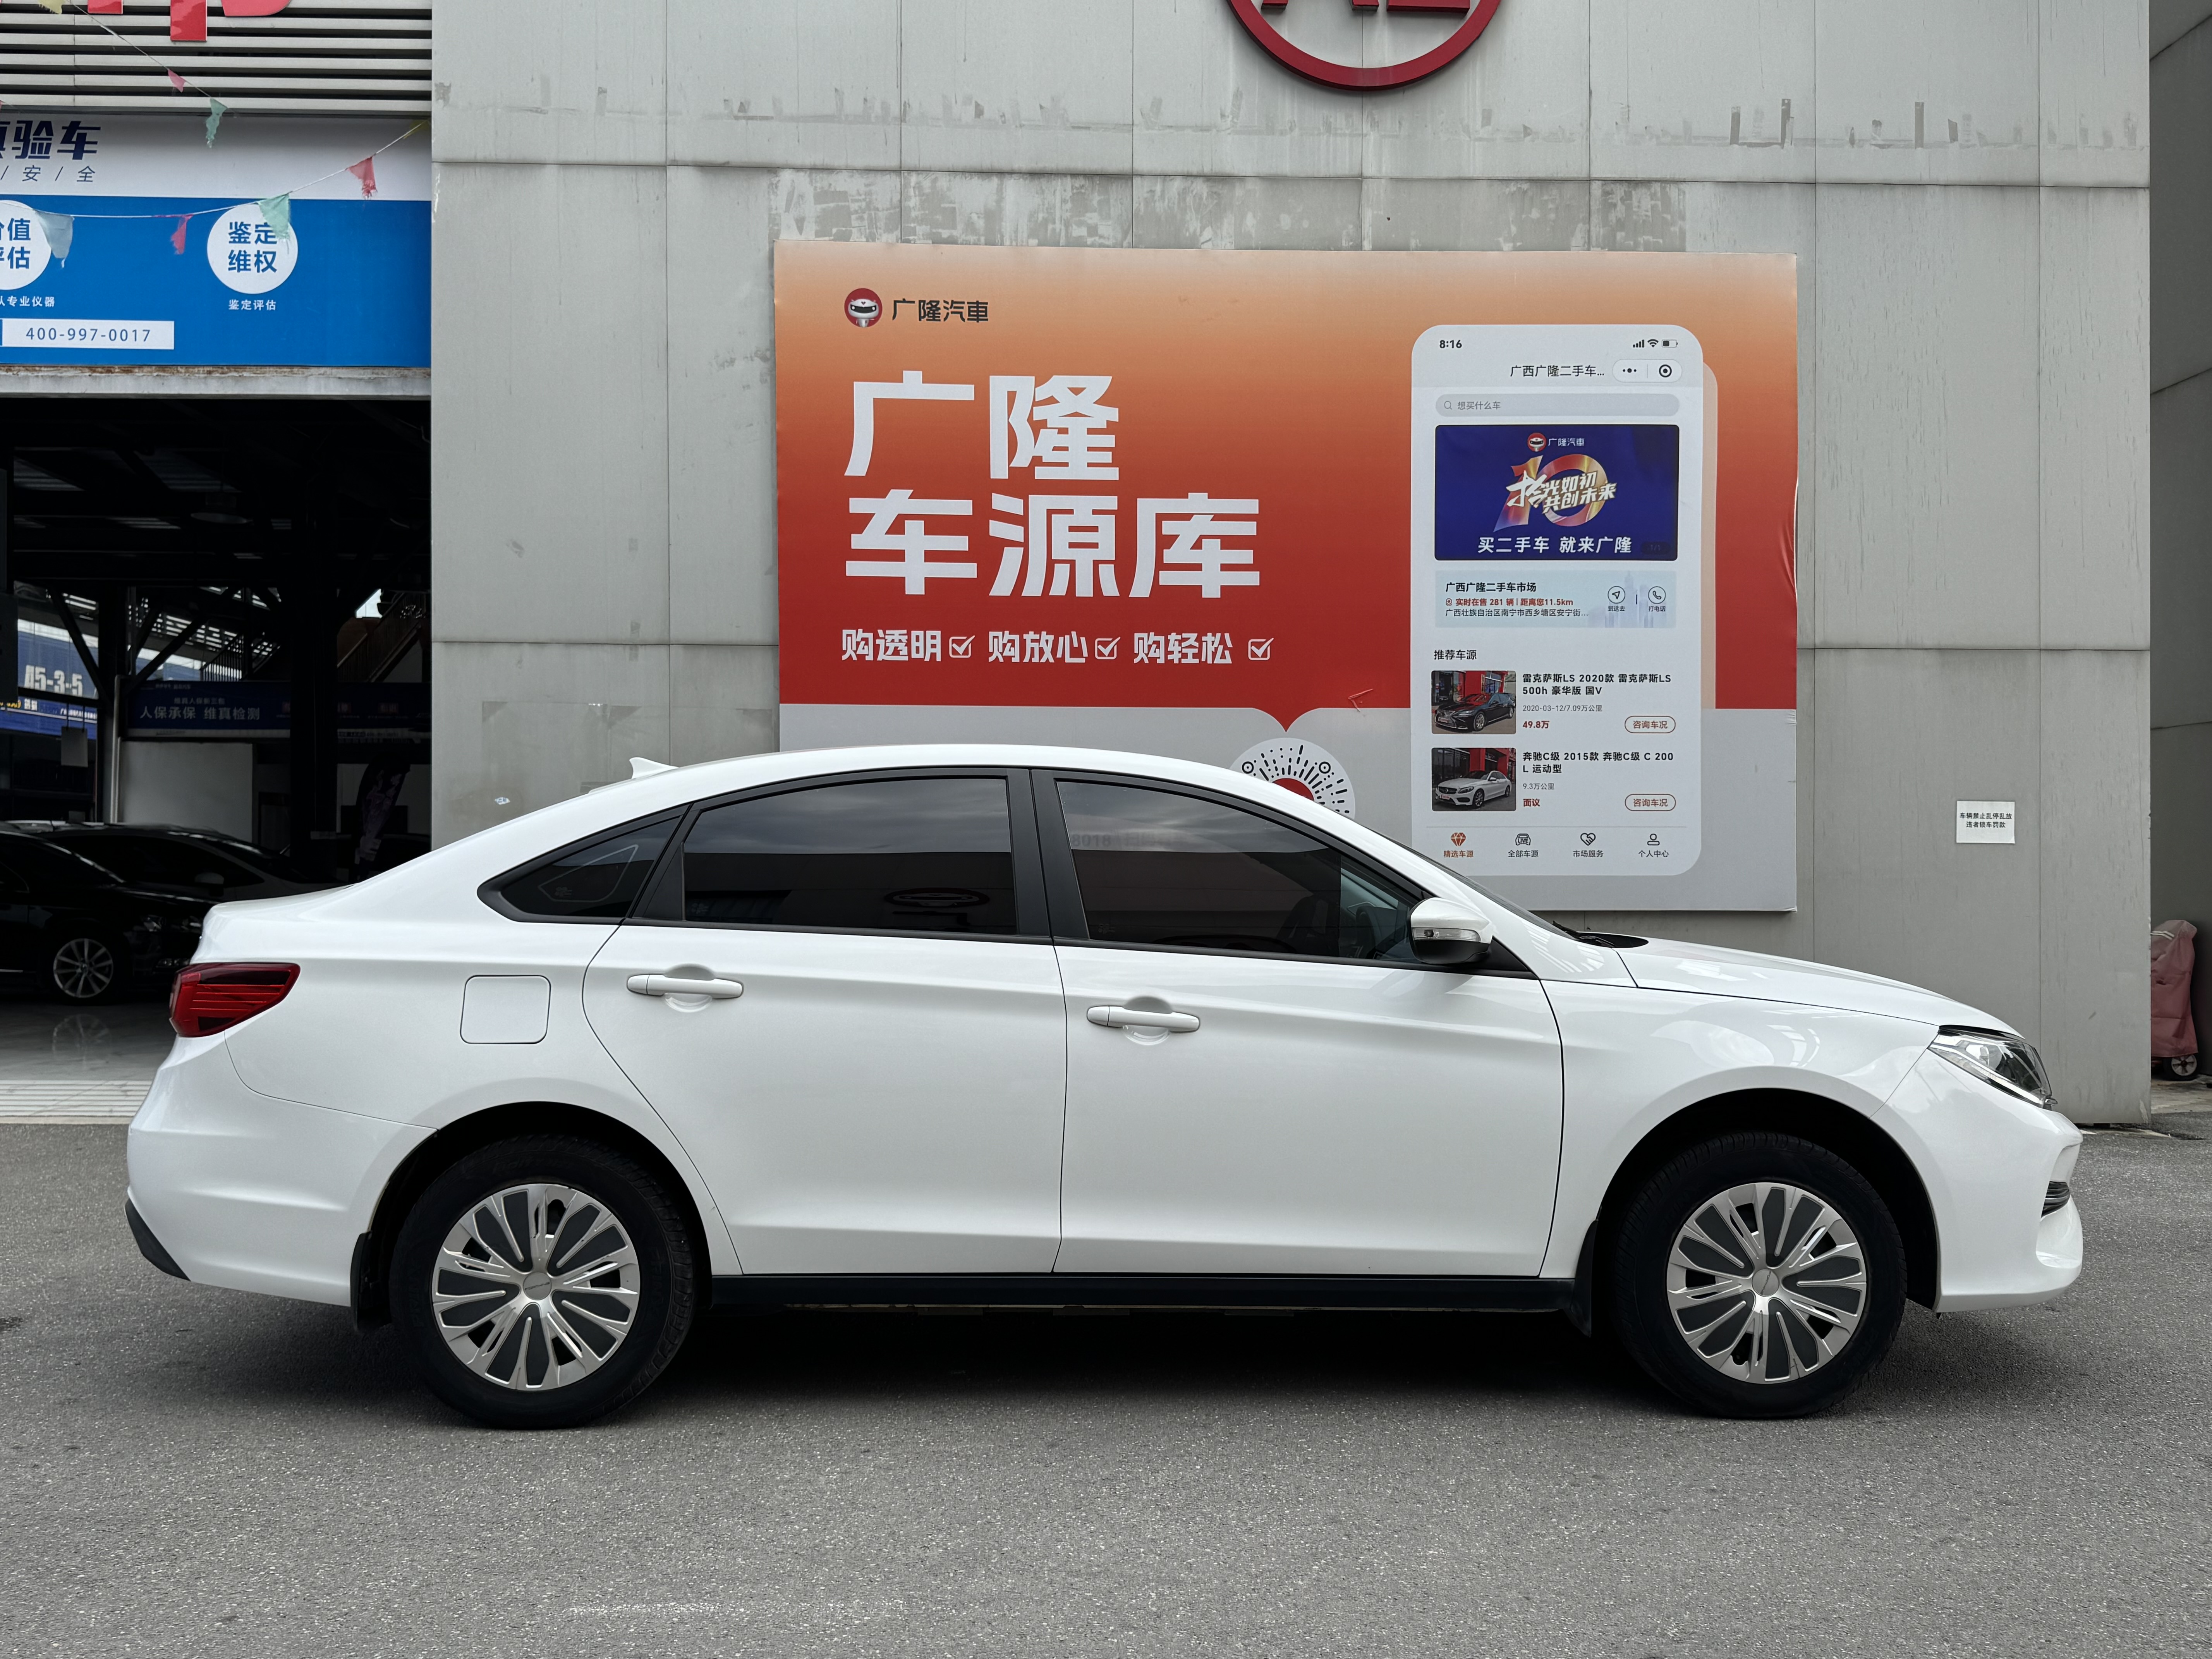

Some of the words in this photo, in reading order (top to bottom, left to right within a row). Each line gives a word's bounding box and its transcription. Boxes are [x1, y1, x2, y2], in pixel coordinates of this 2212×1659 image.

[0, 218, 31, 241] 值
[228, 221, 277, 245] 鉴定
[0, 246, 30, 269] 估
[228, 250, 277, 273] 维权
[229, 299, 276, 310] 鉴定评估
[892, 299, 988, 323] 广隆汽車
[26, 328, 150, 342] 400-997-0017
[1440, 340, 1462, 348] 8:16
[1458, 401, 1500, 410] 想买什么车
[844, 370, 1119, 480] 广隆
[1542, 483, 1617, 514] 共创未来
[846, 489, 1259, 598] 车源库
[1478, 536, 1549, 553] 买二手车
[1559, 536, 1632, 553] 就来广隆
[1446, 582, 1536, 592] 广西广隆二手车市场
[842, 629, 941, 661] 购透明
[989, 631, 1088, 663] 购放心
[1134, 632, 1233, 663] 购轻松
[1434, 650, 1476, 660] 推荐车源
[1523, 673, 1575, 682] 雷克萨斯LS
[1580, 674, 1614, 682] 2020款
[1618, 674, 1671, 682] 雷克萨斯LS
[1552, 686, 1581, 695] 豪华版
[1586, 686, 1602, 695] 国V
[140, 706, 196, 719] 人保承保
[1523, 752, 1559, 761] 奔驰C级
[1564, 752, 1599, 761] 2015款
[1603, 752, 1640, 761] 奔驰C级
[1533, 764, 1561, 773] 运动型
[1523, 799, 1540, 807] 面议
